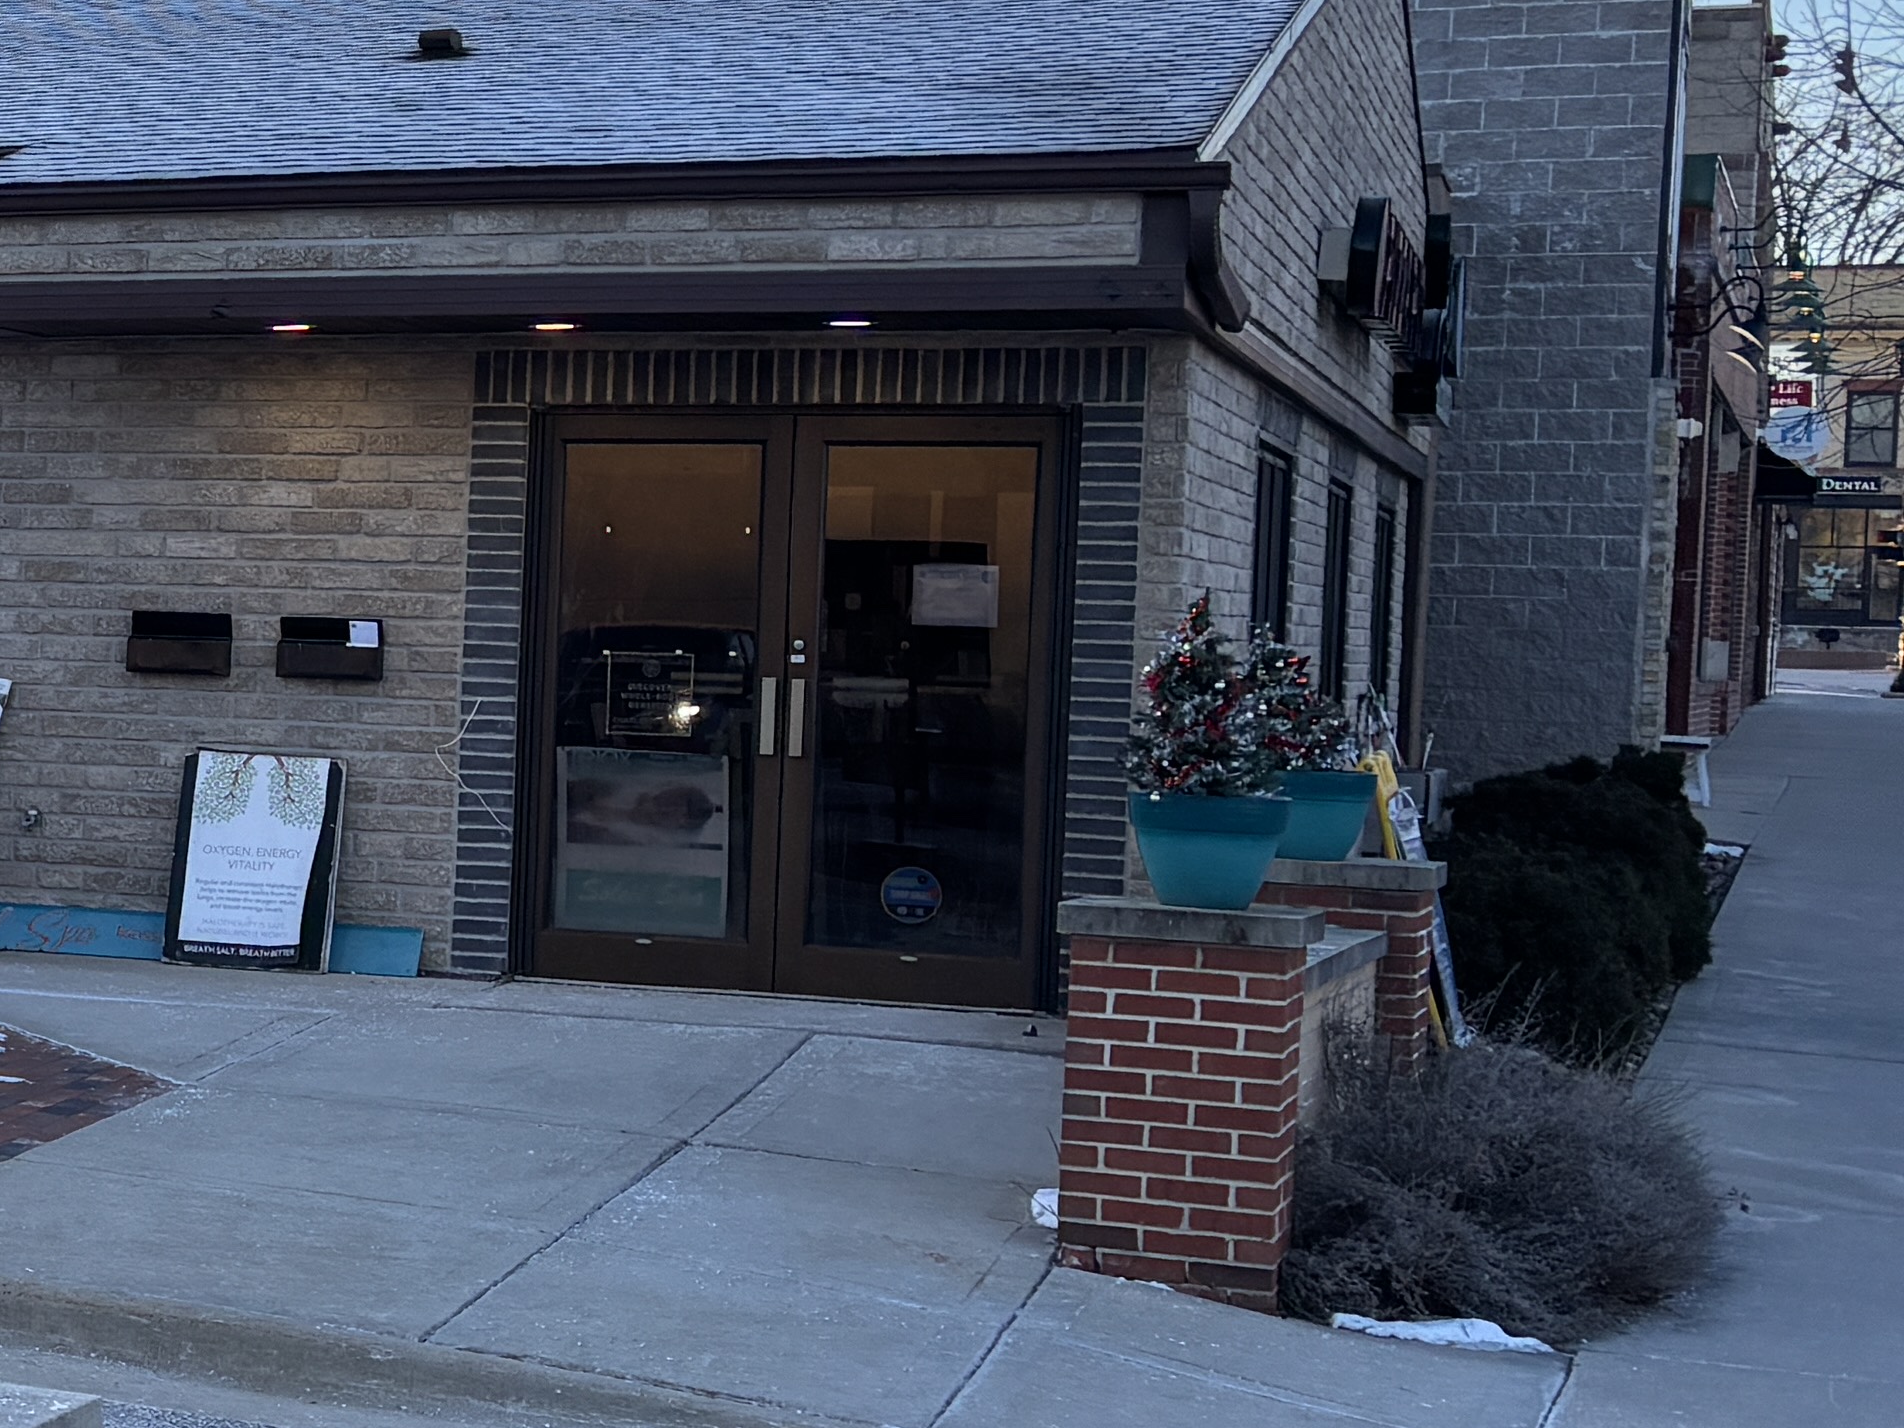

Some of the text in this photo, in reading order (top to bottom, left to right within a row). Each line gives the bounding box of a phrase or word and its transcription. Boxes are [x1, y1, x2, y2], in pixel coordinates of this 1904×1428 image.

[1770, 397, 1799, 405] ness
[1822, 478, 1878, 491] DENTAL
[228, 859, 275, 871] VITALITY
